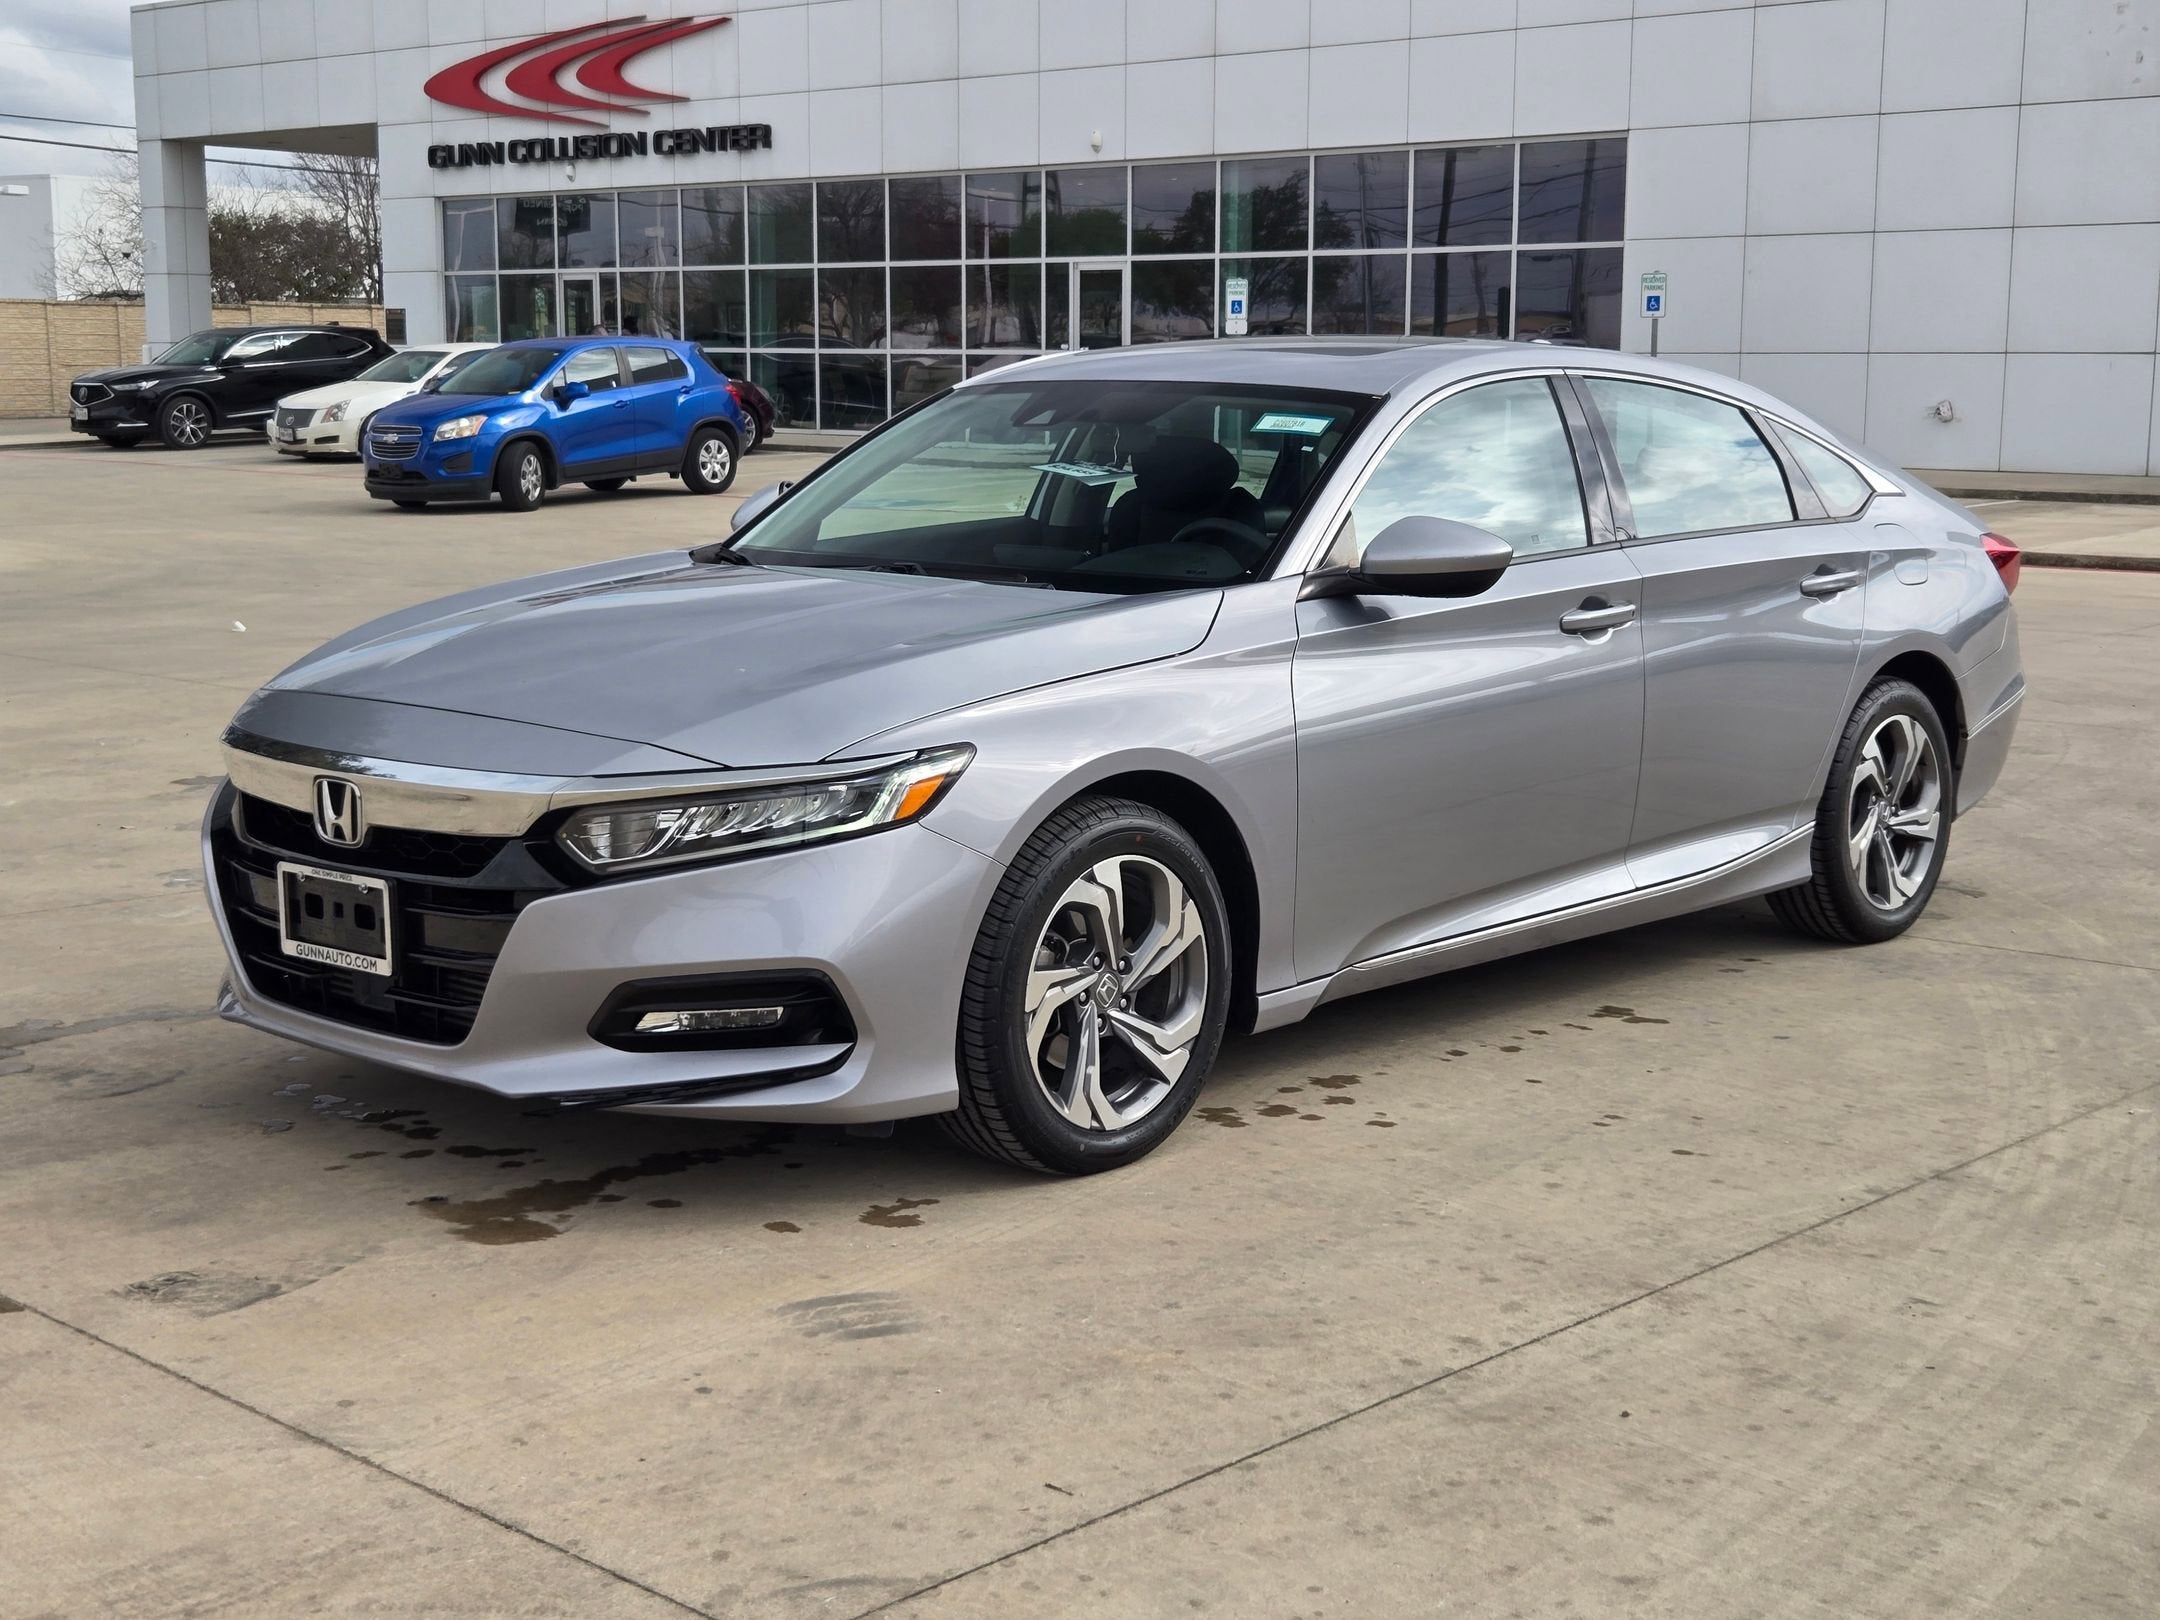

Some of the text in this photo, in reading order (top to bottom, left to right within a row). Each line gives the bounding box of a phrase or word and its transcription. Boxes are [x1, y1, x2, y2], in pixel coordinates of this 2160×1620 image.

[428, 123, 772, 168] GUNN COLLISION CENTER
[296, 943, 378, 972] GUNNAUTO.COM
